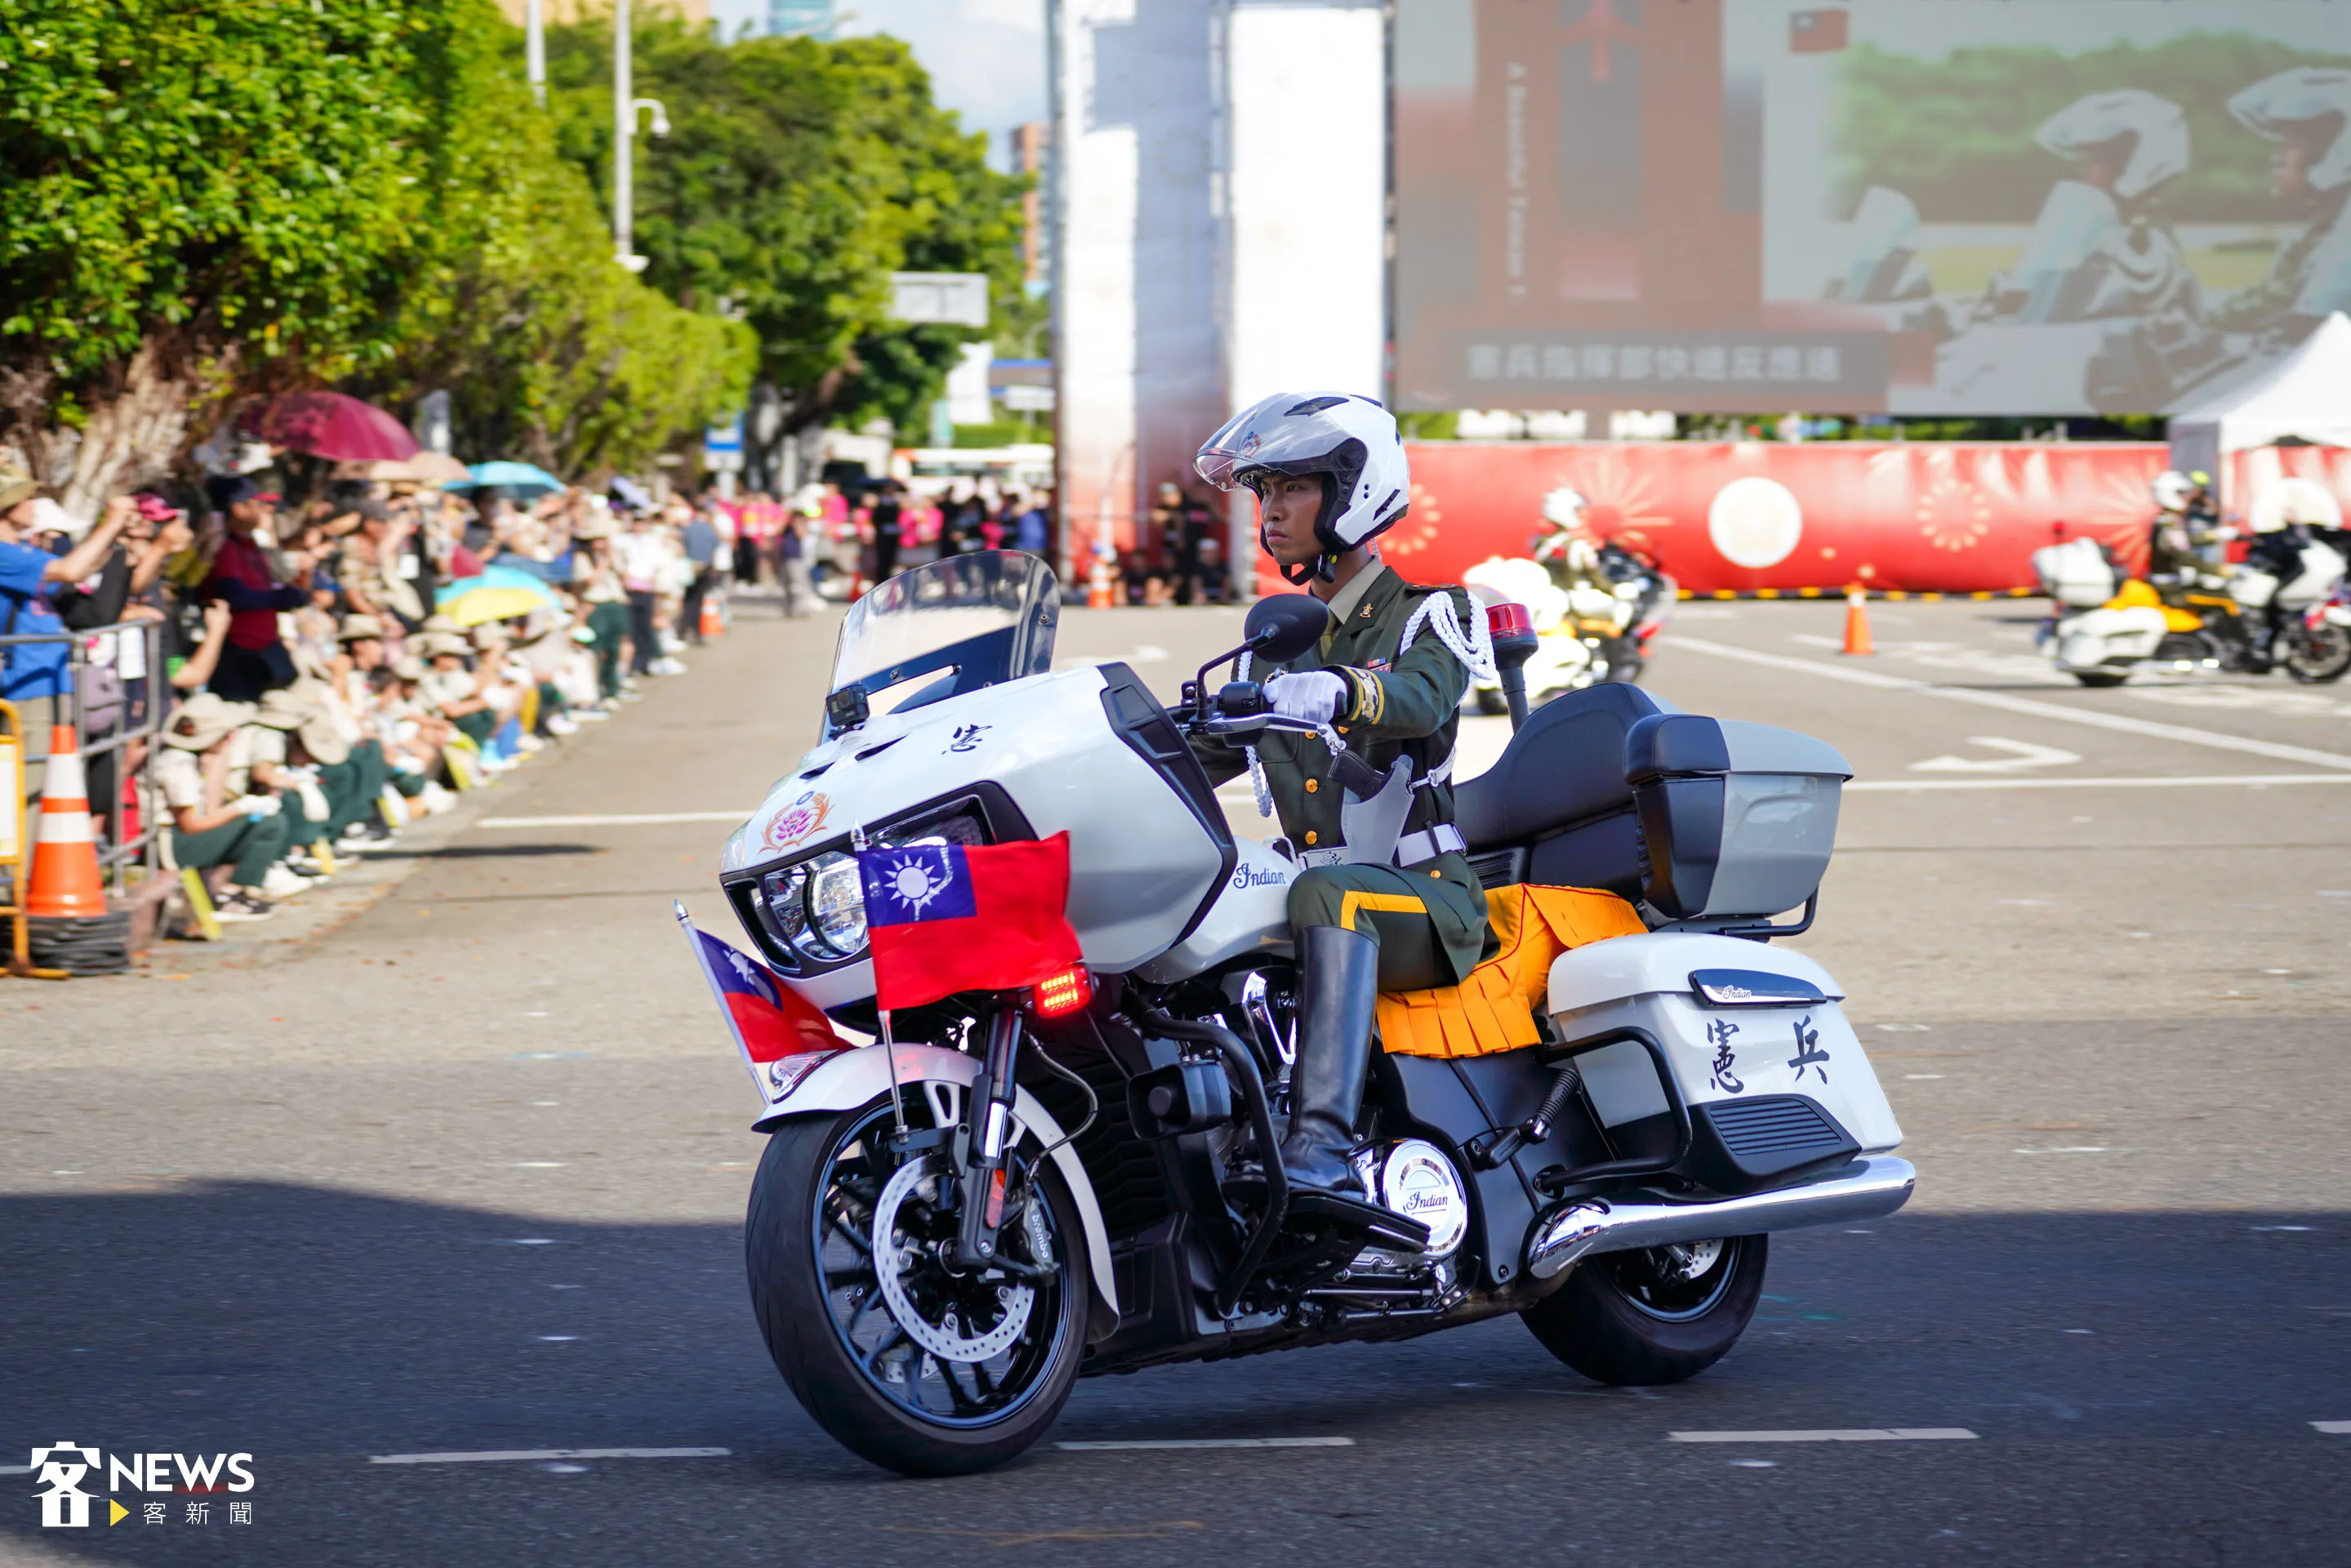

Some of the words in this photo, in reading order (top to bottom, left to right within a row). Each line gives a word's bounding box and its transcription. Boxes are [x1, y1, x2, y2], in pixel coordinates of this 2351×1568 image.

[1233, 862, 1286, 889] Indian
[1723, 985, 1752, 1000] Indian
[1707, 1015, 1830, 1094] 憲兵
[1406, 1192, 1448, 1210] Indian
[1032, 1214, 1049, 1258] brembo
